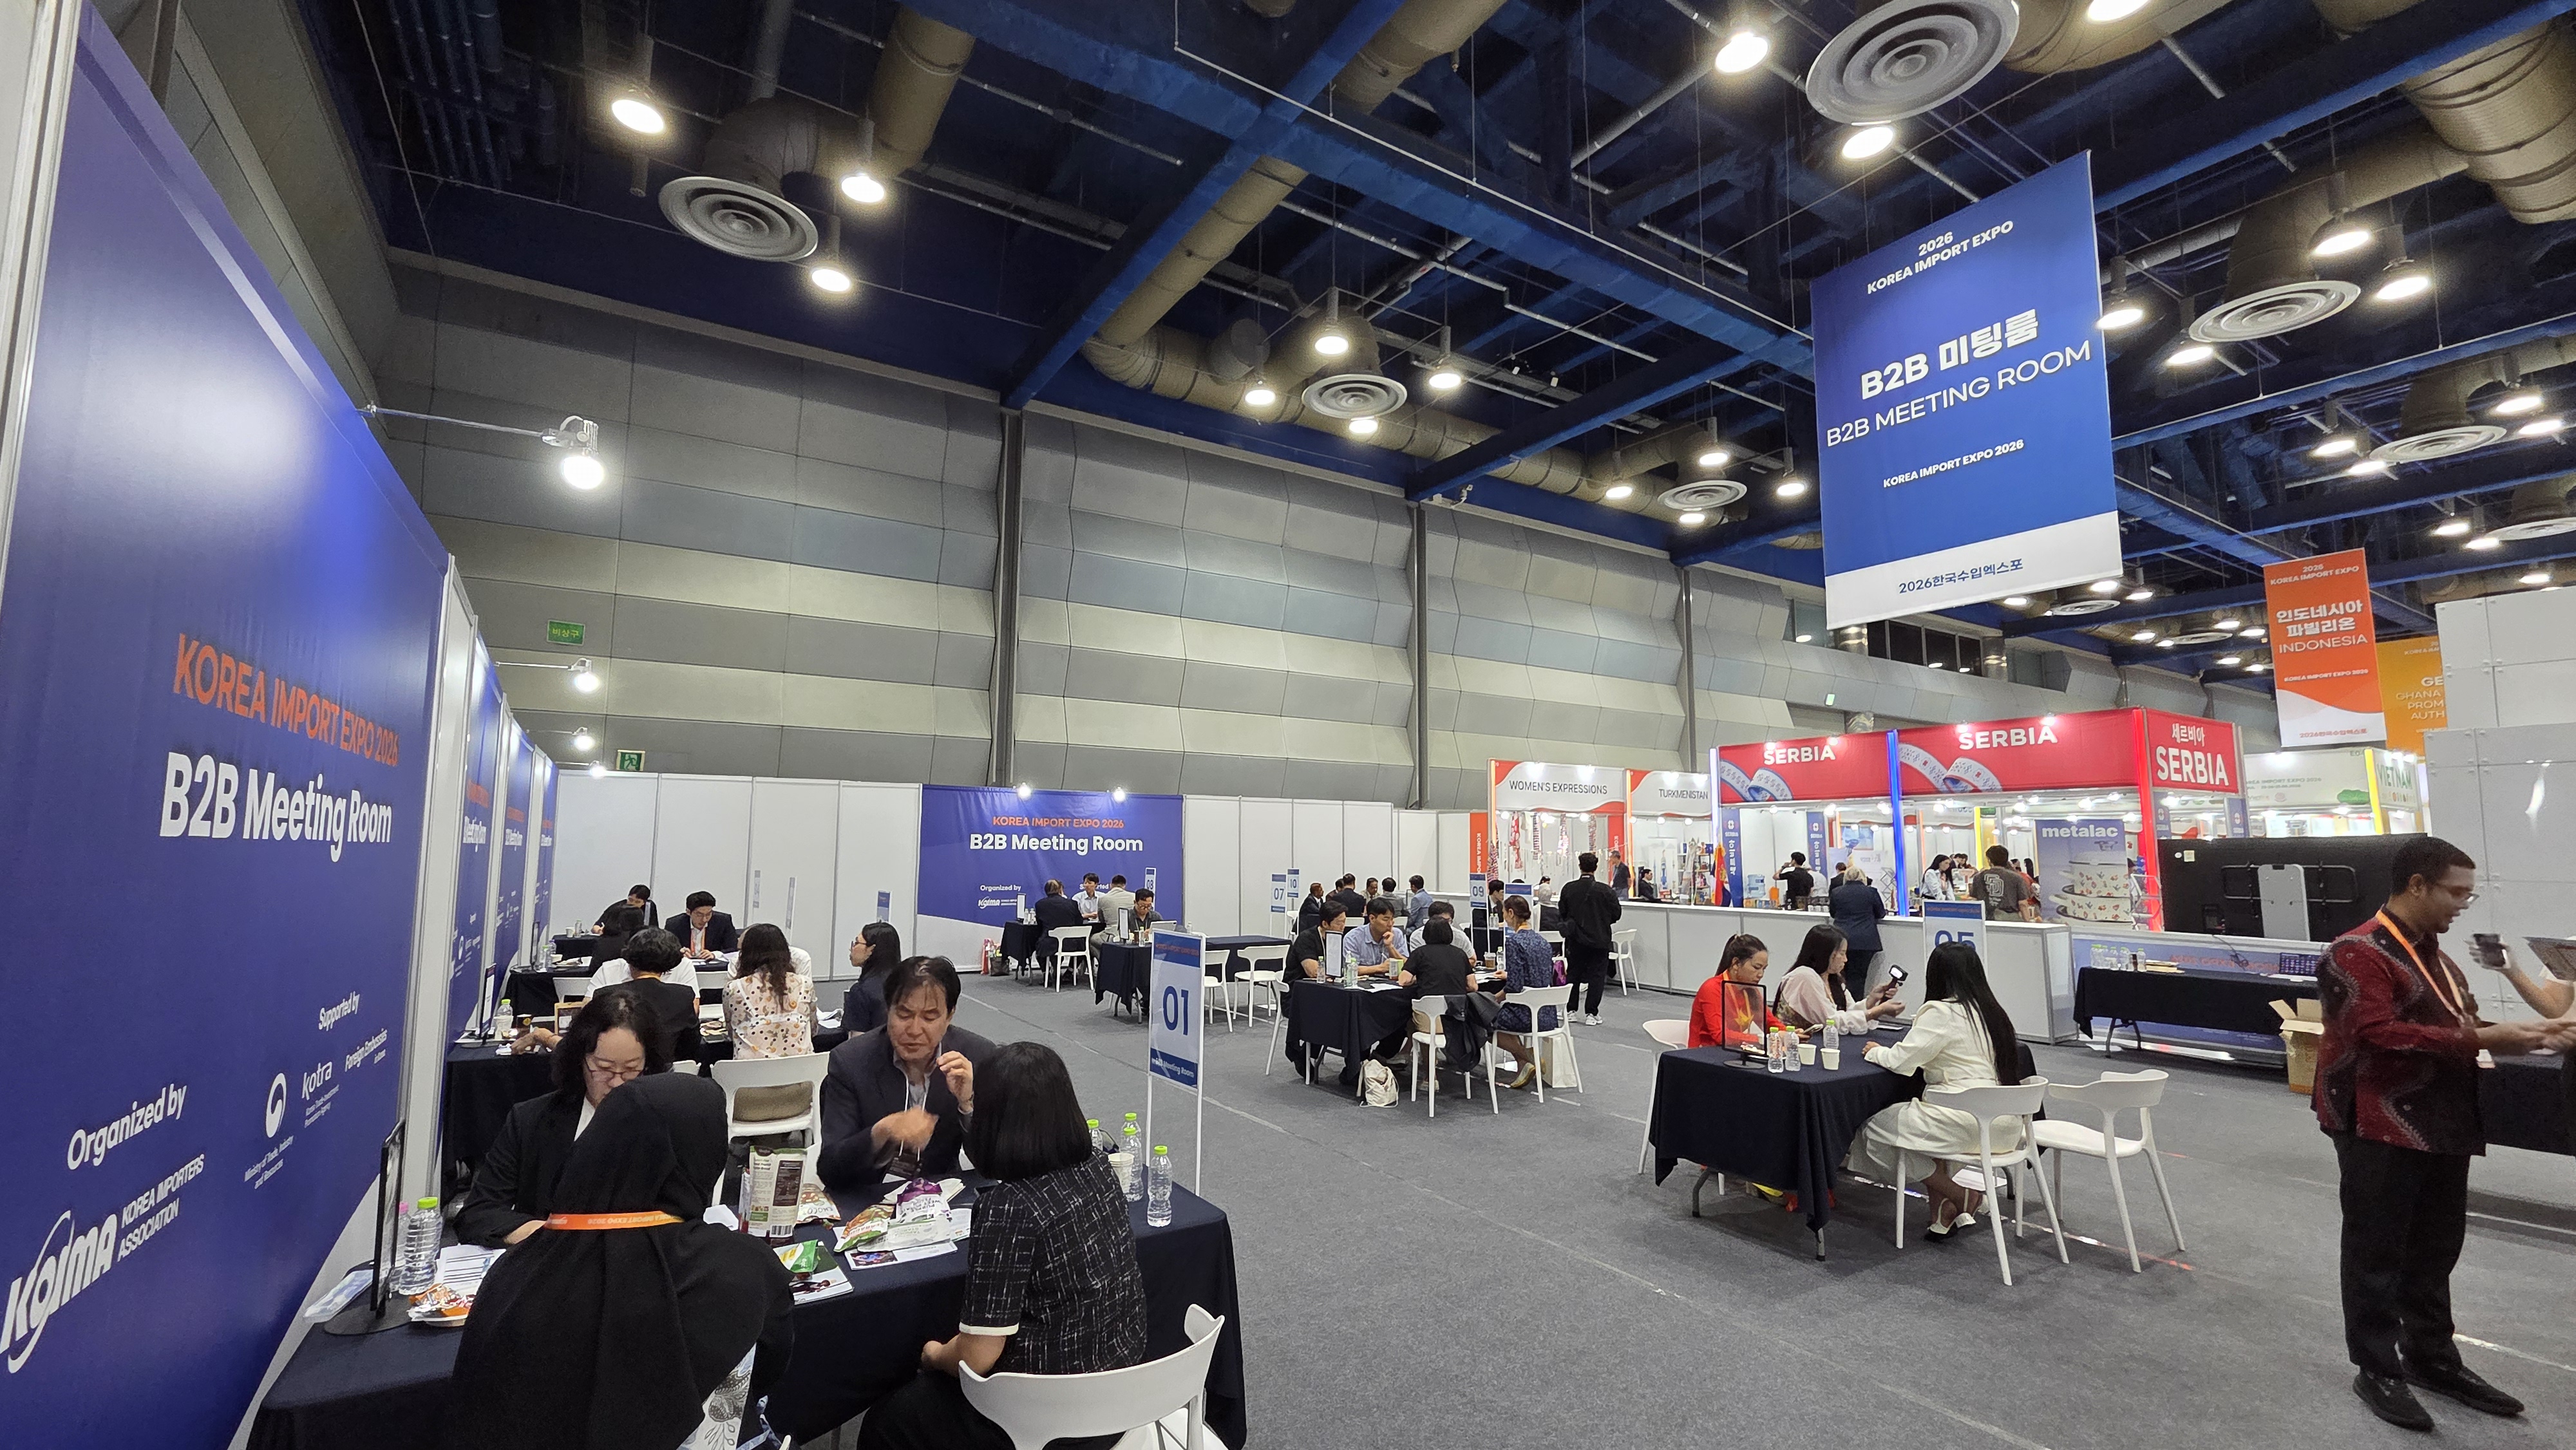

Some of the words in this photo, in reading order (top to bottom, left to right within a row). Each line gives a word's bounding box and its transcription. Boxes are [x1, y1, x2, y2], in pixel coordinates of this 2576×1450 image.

[1918, 231, 1955, 256] 2026
[1867, 267, 1913, 295] KOREA
[1915, 240, 1969, 273] IMPORT
[1971, 220, 2014, 250] EXPO
[1861, 353, 1929, 400] B2B
[1938, 308, 2039, 372] 미팅룸
[1826, 419, 1870, 447] B2B
[1875, 375, 1991, 431] MEETING
[1998, 340, 2091, 390] ROOM
[1883, 470, 1918, 488] KOREA
[1919, 458, 1961, 478] IMPORT
[1962, 448, 1994, 467] EXPO
[1994, 438, 2024, 457] 2026
[1898, 558, 2024, 594] 2026한국수입엑스포
[2270, 576, 2299, 585] KOREA
[2300, 570, 2333, 581] IMPORT
[2335, 565, 2360, 576] EXPO
[2276, 599, 2363, 623] 인도네시아
[552, 628, 580, 639] 비상구
[2287, 617, 2356, 637] 파빌리온
[2278, 634, 2368, 654] INDONESIA
[2421, 677, 2444, 687] GE
[173, 633, 266, 728] KOREA
[270, 678, 340, 745] IMPORT
[340, 710, 375, 759] EXPO
[375, 726, 399, 767] 2026
[2396, 690, 2441, 701] GHANA
[2407, 701, 2444, 710] PROM
[2410, 711, 2445, 720] AUTH
[1959, 725, 2058, 751] SERBIA
[2172, 723, 2206, 747] 세르비아
[1764, 744, 1835, 765] SERBIA
[2156, 746, 2230, 786] SERBIA
[1509, 780, 1551, 793] WOMEN'S
[1552, 782, 1607, 795] EXPRESSIONS
[1658, 789, 1709, 800] TURKMENISTAN
[160, 751, 239, 839] B2B
[243, 768, 348, 862] Meeting
[347, 789, 392, 843] Room
[992, 816, 1030, 827] KOREA
[1032, 816, 1071, 828] IMPORT
[1074, 818, 1099, 829] EXPO
[1101, 818, 1124, 829] 2026
[2041, 824, 2119, 838] metalac
[970, 834, 1007, 851] B2B
[1011, 834, 1088, 856] Meeting
[1093, 836, 1143, 852] Room
[1274, 887, 1284, 901] 07
[1290, 879, 1297, 889] 10
[1472, 886, 1484, 897] 09
[319, 992, 352, 1031] Supported
[1162, 986, 1189, 1036] 01
[301, 1062, 332, 1100] kotra
[68, 1087, 166, 1170] Organized
[167, 1083, 187, 1120] by
[121, 1189, 155, 1229] KOREA
[156, 1153, 205, 1203] IMPORTERS
[117, 1198, 180, 1263] ASSOCIATION
